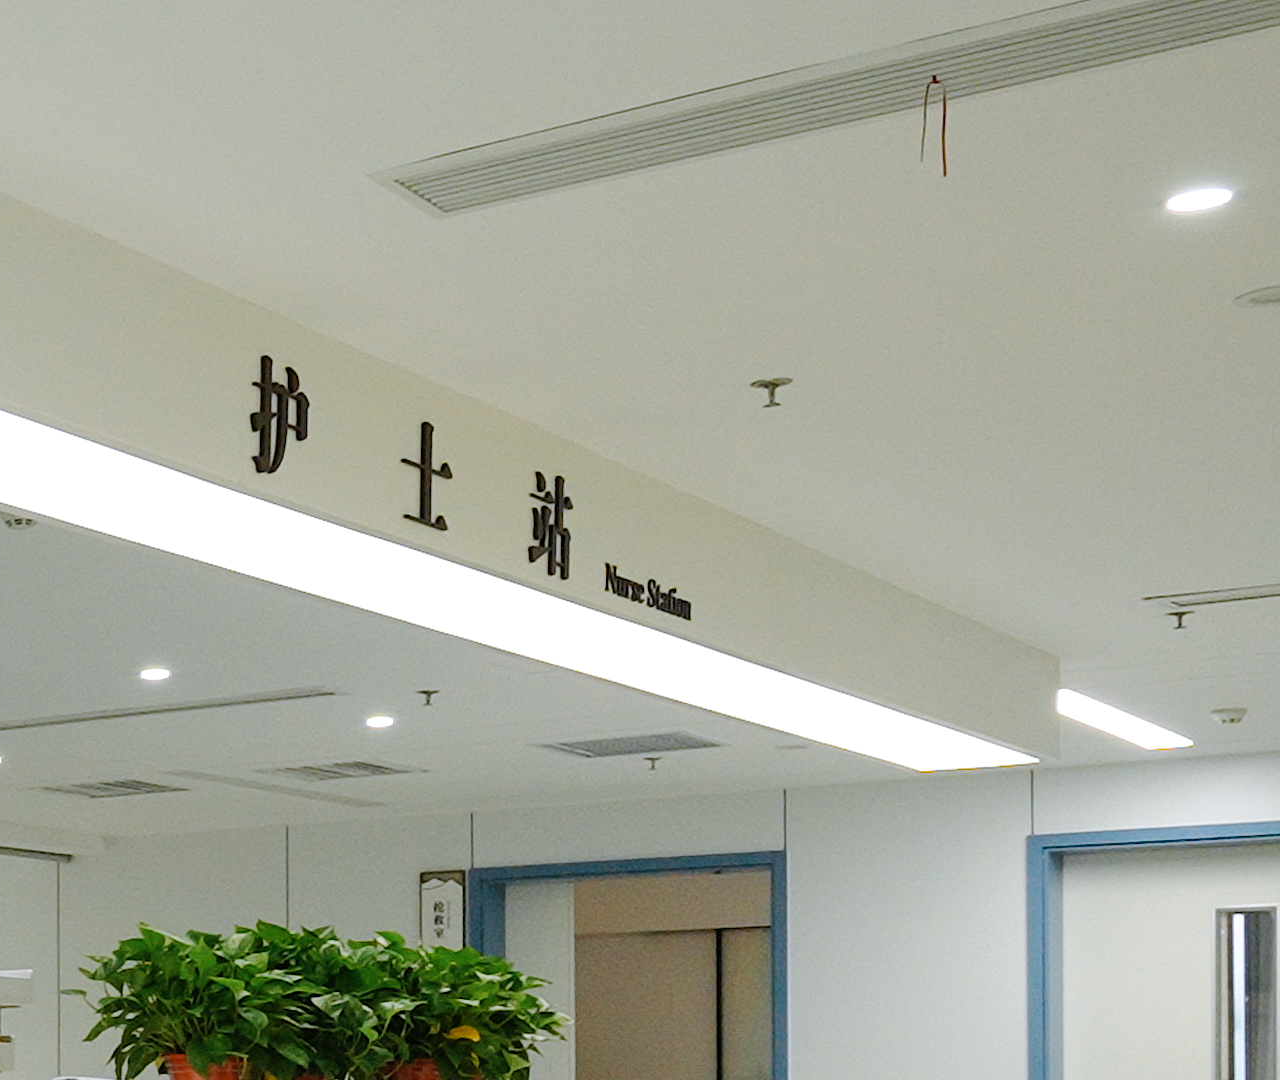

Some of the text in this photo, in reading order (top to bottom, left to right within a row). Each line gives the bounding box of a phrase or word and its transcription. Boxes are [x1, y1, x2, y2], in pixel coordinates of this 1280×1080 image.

[250, 355, 574, 580] 护士站
[604, 562, 692, 621] Nurse Station
